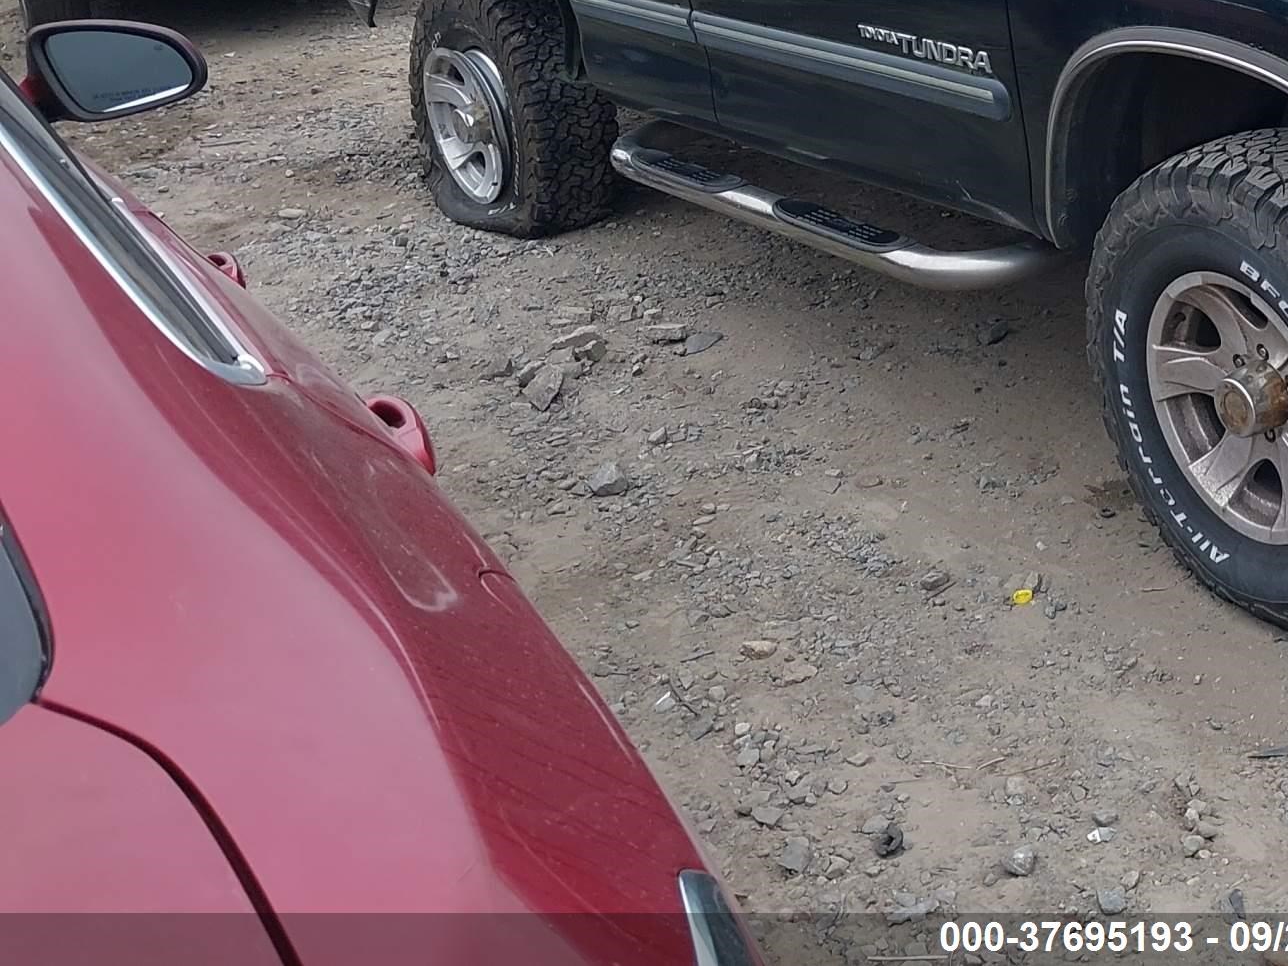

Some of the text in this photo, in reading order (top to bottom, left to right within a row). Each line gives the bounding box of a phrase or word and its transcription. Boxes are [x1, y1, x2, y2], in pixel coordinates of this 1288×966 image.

[857, 24, 993, 75] TOYOTA TUNDRA
[1112, 308, 1129, 364] T/A
